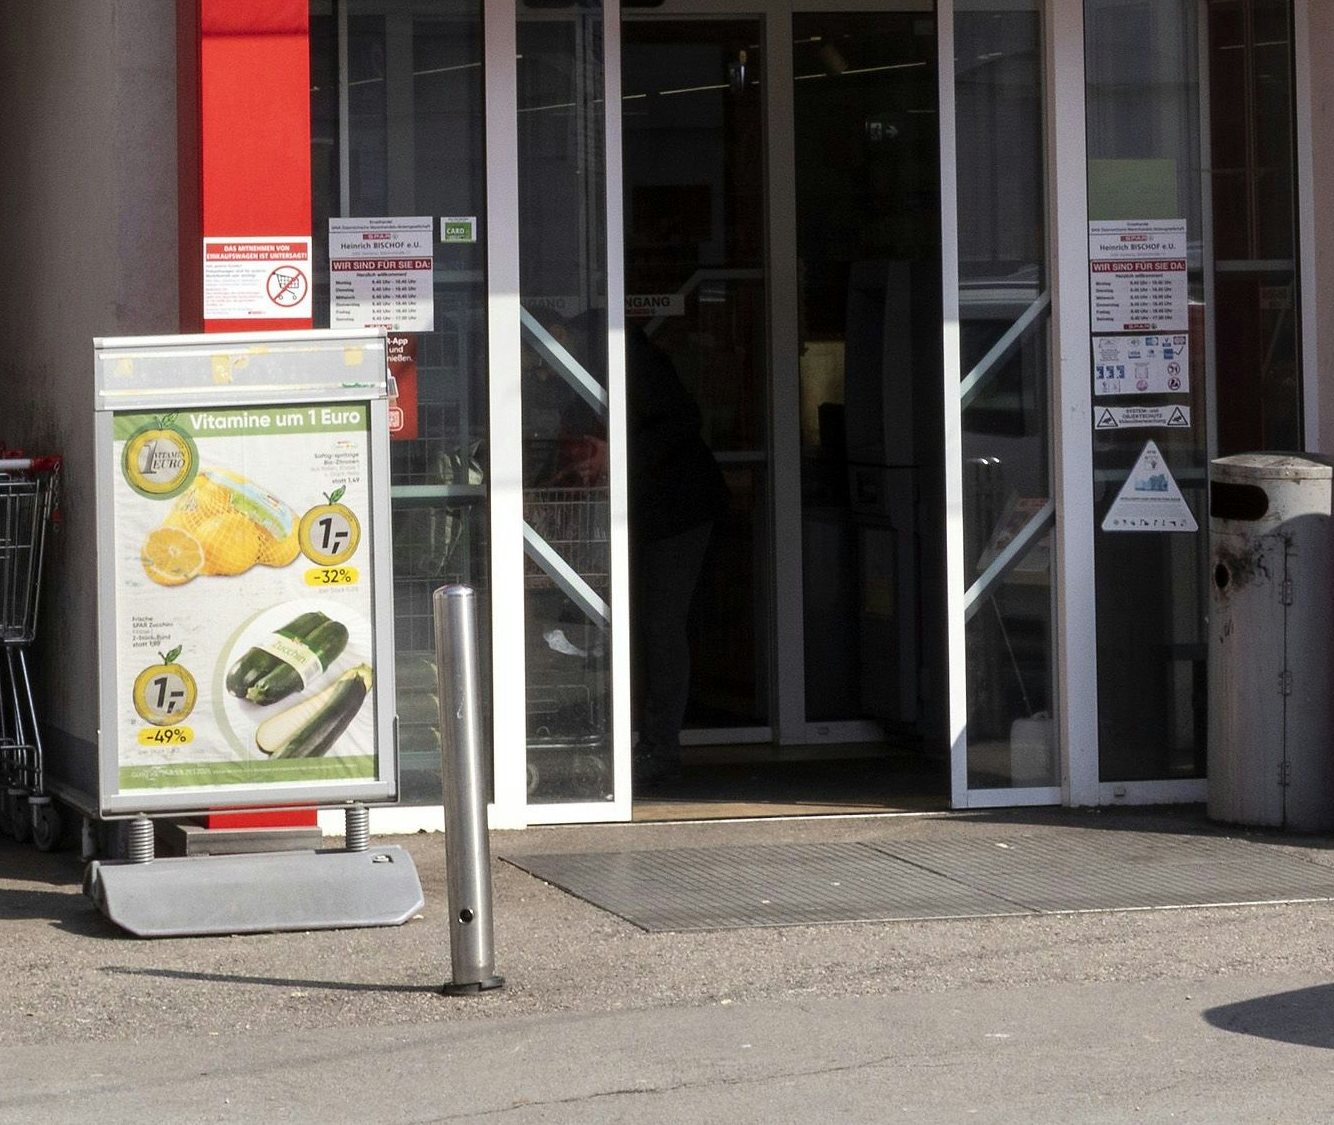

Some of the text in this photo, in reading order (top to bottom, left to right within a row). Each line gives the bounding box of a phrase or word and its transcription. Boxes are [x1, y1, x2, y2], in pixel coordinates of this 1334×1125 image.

[447, 227, 465, 235] CARD
[340, 241, 371, 250] Heinrich
[373, 241, 404, 249] BISCHOF
[333, 262, 352, 270] WIR
[353, 261, 376, 270] SIND
[377, 260, 397, 269] FÜR
[1093, 261, 1185, 271] WIR SIND FÜR SIE DA:
[626, 297, 670, 308] NGANG
[190, 409, 360, 431] Vitamine um 1 Euro
[139, 439, 185, 474] 1 VITAMIN
[153, 459, 186, 469] EURO
[314, 568, 352, 584] -32%
[146, 729, 187, 743] -49%
